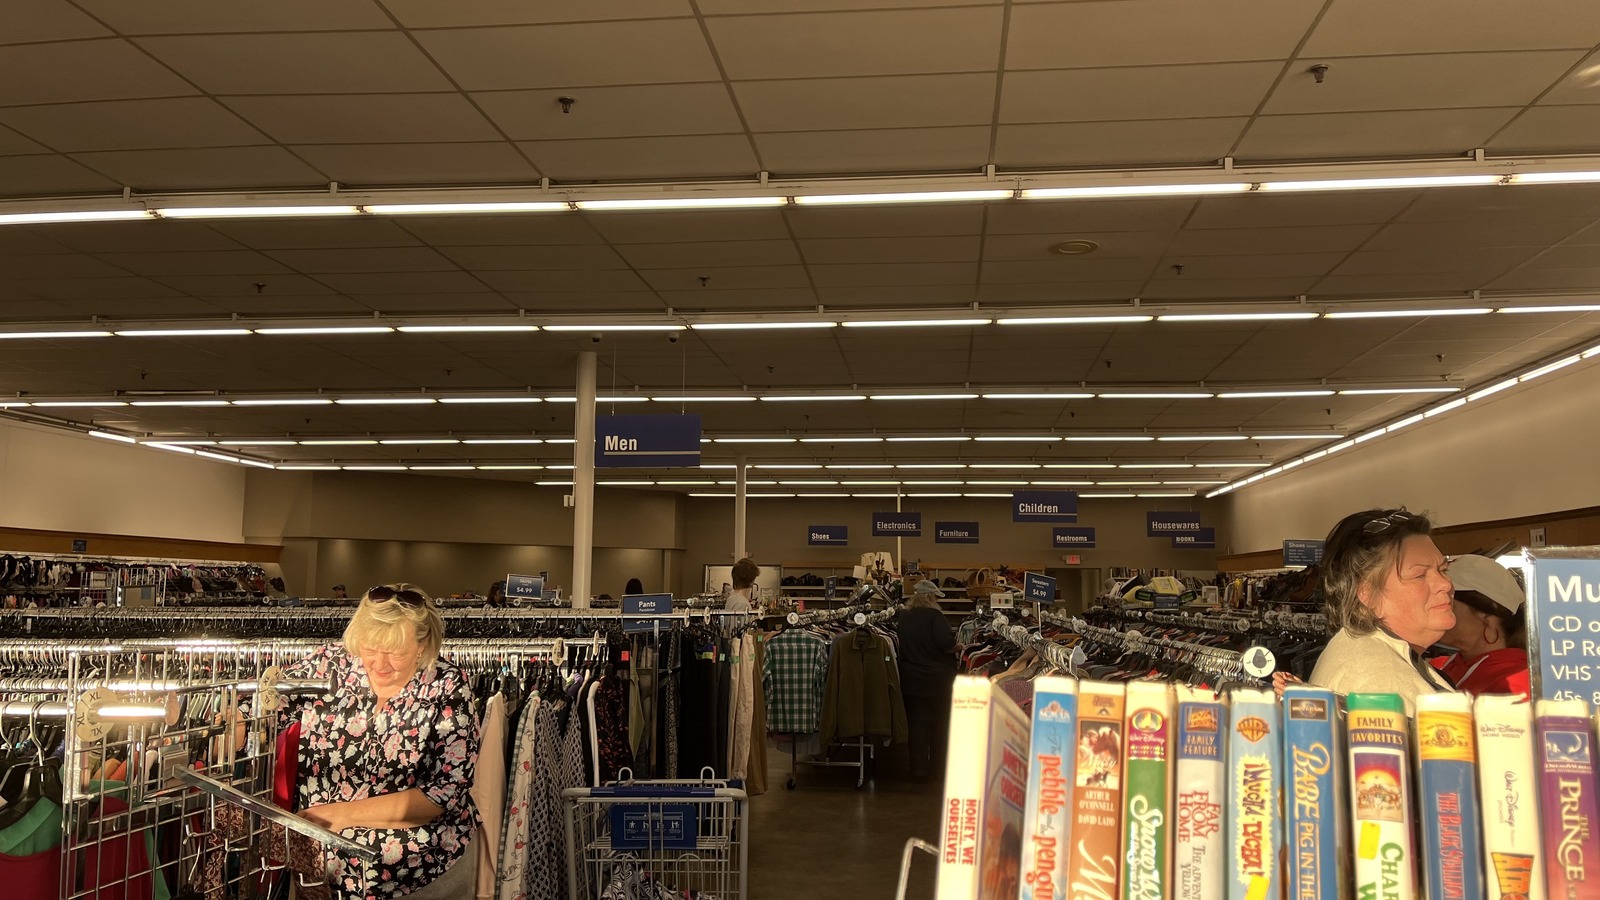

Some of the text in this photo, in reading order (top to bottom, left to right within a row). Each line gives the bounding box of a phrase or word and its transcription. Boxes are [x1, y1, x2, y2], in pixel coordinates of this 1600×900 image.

[605, 435, 637, 451] Men
[1019, 503, 1058, 513] Children
[877, 521, 916, 530] Electronics
[1152, 521, 1200, 529] Housewares
[811, 532, 830, 540] Shoes
[1031, 578, 1049, 586] Sweaters
[1032, 589, 1047, 597] $4.99
[1549, 615, 1582, 633] CD
[1551, 640, 1575, 656] LP
[1551, 664, 1592, 681] VHS
[90, 691, 101, 702] XL
[1356, 717, 1394, 729] FAMILY
[1480, 723, 1526, 735] Walt Disney
[1143, 733, 1166, 745] Disney
[1187, 735, 1215, 745] FAMILY
[1351, 732, 1404, 745] FAVORITES
[1184, 745, 1218, 756] FEATURE
[1037, 753, 1067, 815] pebble
[1293, 742, 1331, 820] BABE
[1085, 790, 1111, 801] ARTHUR
[1504, 771, 1520, 828] Walt Disney
[1079, 801, 1115, 812] O'CONNELL
[1078, 814, 1097, 825] DAVID
[1178, 793, 1193, 843] HOME
[1192, 791, 1209, 839] FROM
[1206, 801, 1222, 837] FAR
[945, 798, 960, 864] OURSELVES
[1130, 795, 1163, 871] Snow
[1558, 776, 1585, 881] PRINCE
[1580, 815, 1590, 840] THE
[1438, 792, 1464, 899] THE BLACK STALLION
[961, 847, 974, 865] WE
[1193, 845, 1206, 864] THE
[1300, 821, 1316, 900] PIG IN THE
[1181, 863, 1192, 899] YELLOW
